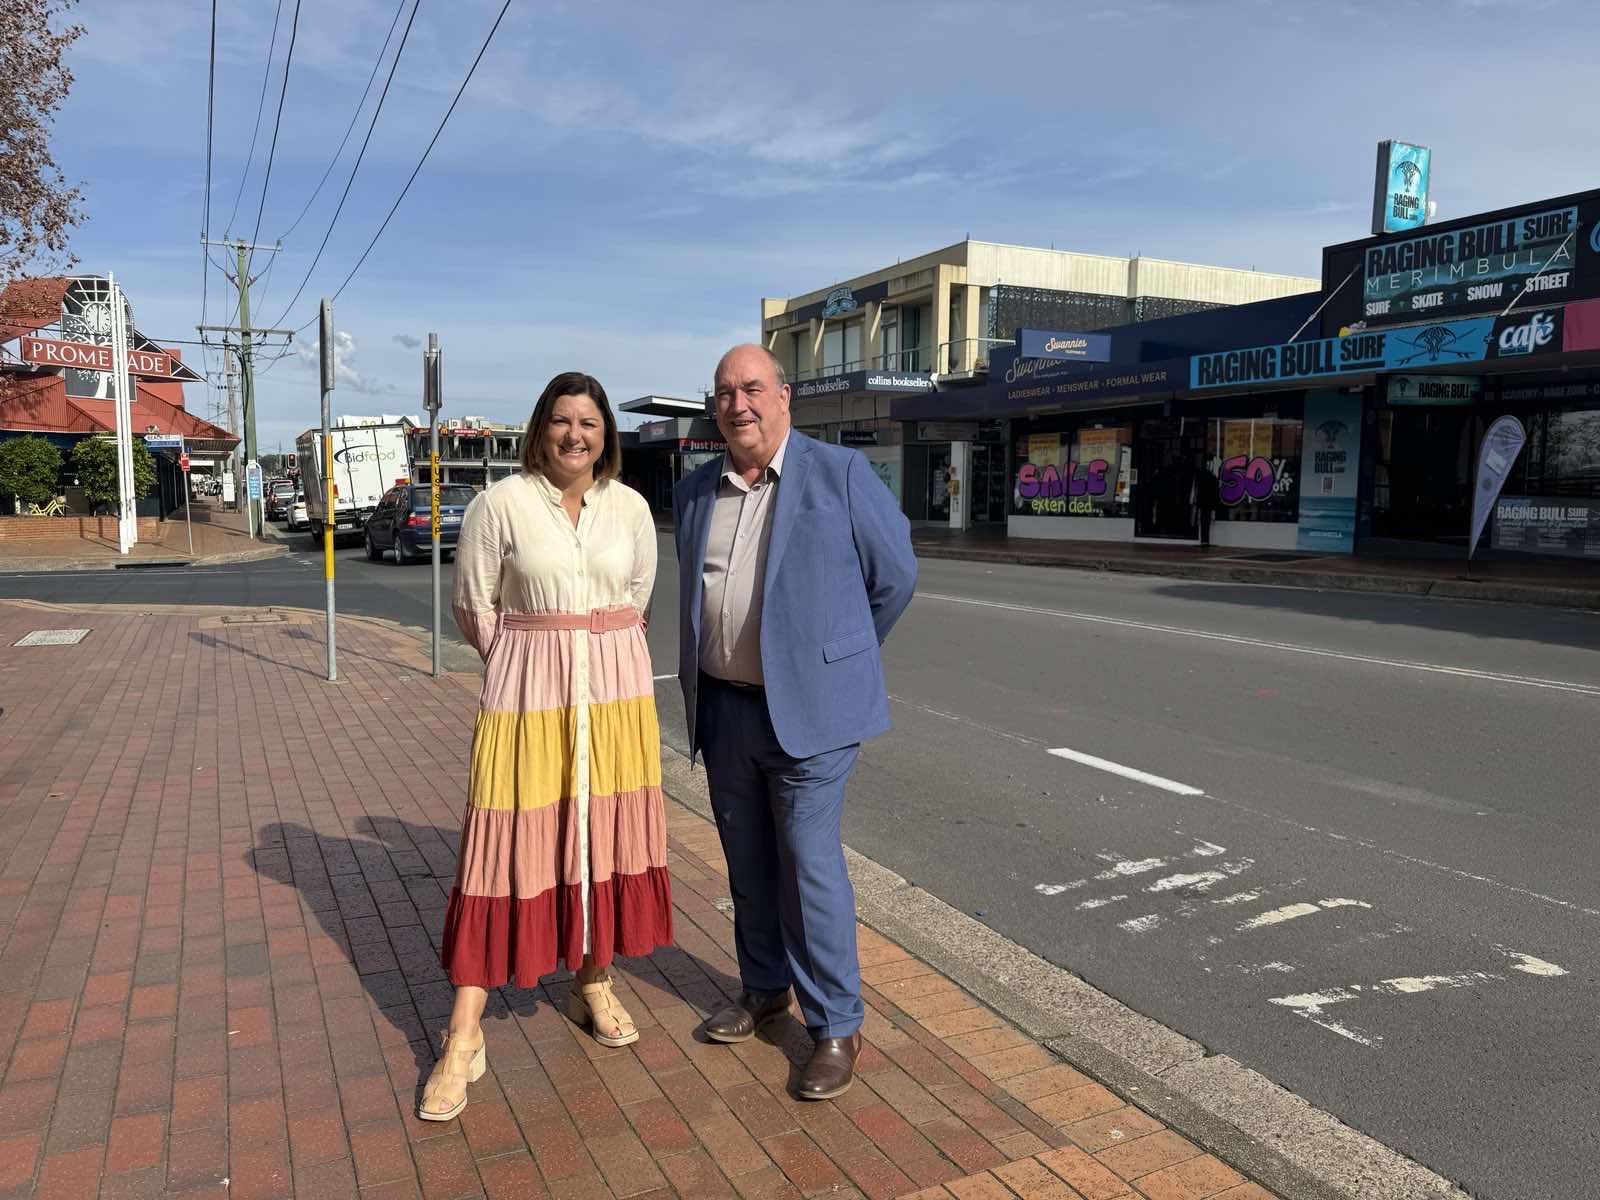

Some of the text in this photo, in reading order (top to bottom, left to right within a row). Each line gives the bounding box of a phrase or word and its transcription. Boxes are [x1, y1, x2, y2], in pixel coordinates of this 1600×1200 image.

[1394, 192, 1420, 209] RAGING
[1393, 206, 1408, 219] BULL
[1367, 210, 1573, 278] RAGING BULL SURF
[1366, 244, 1571, 294] MERIMBULA
[1365, 272, 1571, 316] SURF SKATE SNOW STREET
[1499, 312, 1556, 353] café
[1045, 337, 1088, 353] Swannies
[32, 342, 164, 373] PROMEADE
[1198, 334, 1387, 386] RAGING BULL SURF
[797, 378, 850, 397] collins booksellers
[867, 375, 891, 386] collins
[1008, 371, 1167, 401] LADIESWEAR MENSWEAR FORMAL WEAR
[1418, 383, 1471, 399] RAGING BULL
[690, 440, 708, 451] Just
[345, 450, 395, 464] Bidfood
[1018, 458, 1109, 498] SALE
[1496, 506, 1538, 520] RAGING
[1539, 507, 1566, 520] BULL
